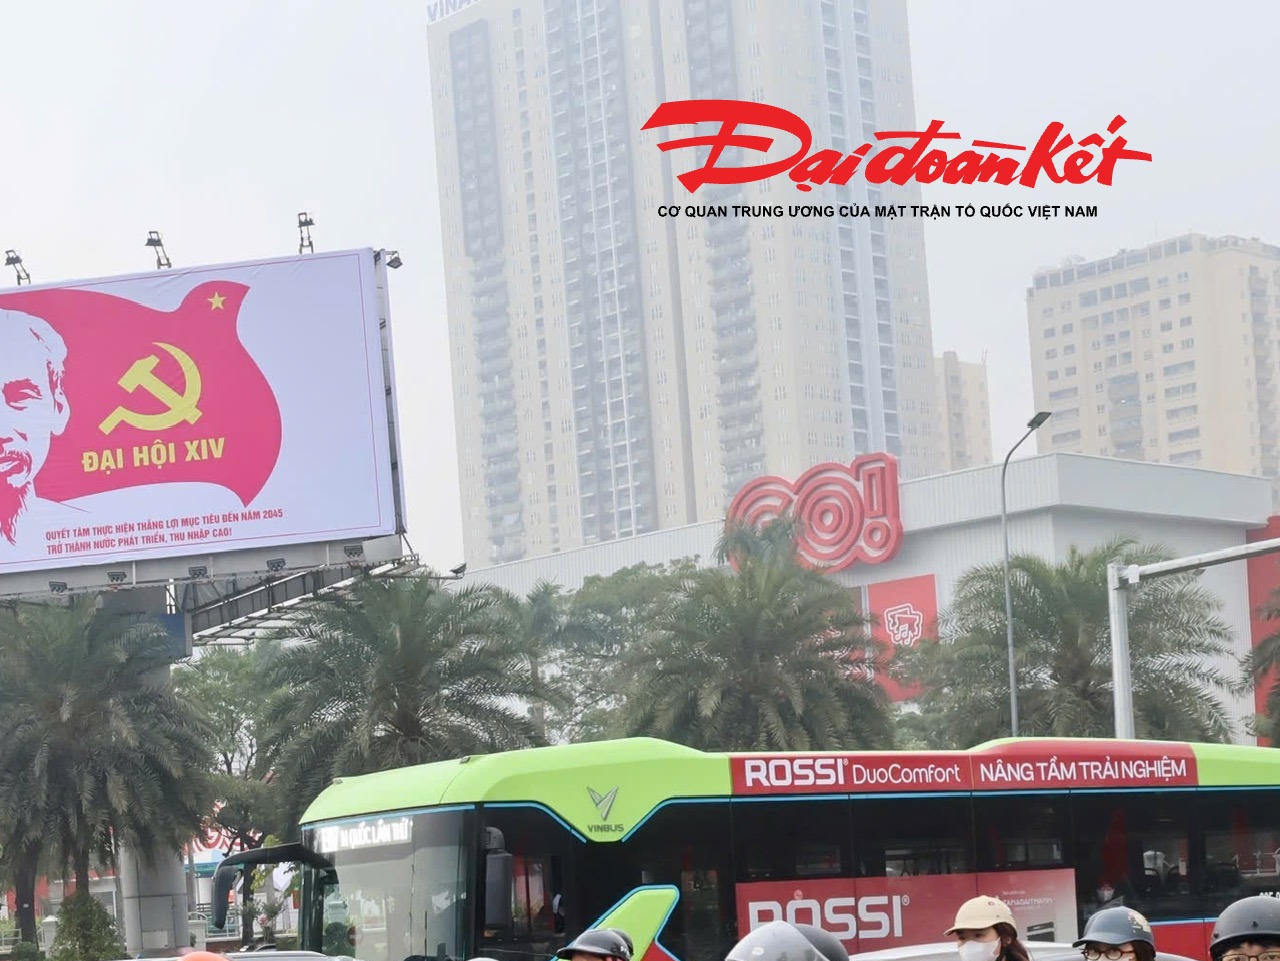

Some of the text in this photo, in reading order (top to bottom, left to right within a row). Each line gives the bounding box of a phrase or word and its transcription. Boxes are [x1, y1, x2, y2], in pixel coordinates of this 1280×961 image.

[81, 437, 226, 475] ĐẠI HỘI XIV
[45, 527, 71, 541] QUYẾT
[72, 526, 90, 538] TÂM
[92, 525, 114, 538] THỰC
[115, 522, 135, 536] HIỆN
[165, 518, 179, 531] LỢI
[181, 516, 200, 529] MỤC
[202, 512, 221, 525] TIÊU
[222, 510, 239, 523] ĐẾN
[240, 508, 261, 522] NĂM
[263, 508, 284, 519] 2045
[46, 540, 63, 555] TRỞ
[65, 540, 92, 553] THÀNH
[118, 534, 139, 547] PHÁT
[170, 532, 186, 543] THU
[187, 528, 210, 542] NHẬP
[212, 527, 233, 538] CAO!
[852, 763, 961, 785] DuoComfort
[979, 758, 1035, 782] NÂNG
[1036, 756, 1077, 780] TẦM
[1078, 756, 1119, 780] TRẢI
[1121, 756, 1187, 782] NGHIỆM
[587, 824, 625, 833] VINBUS
